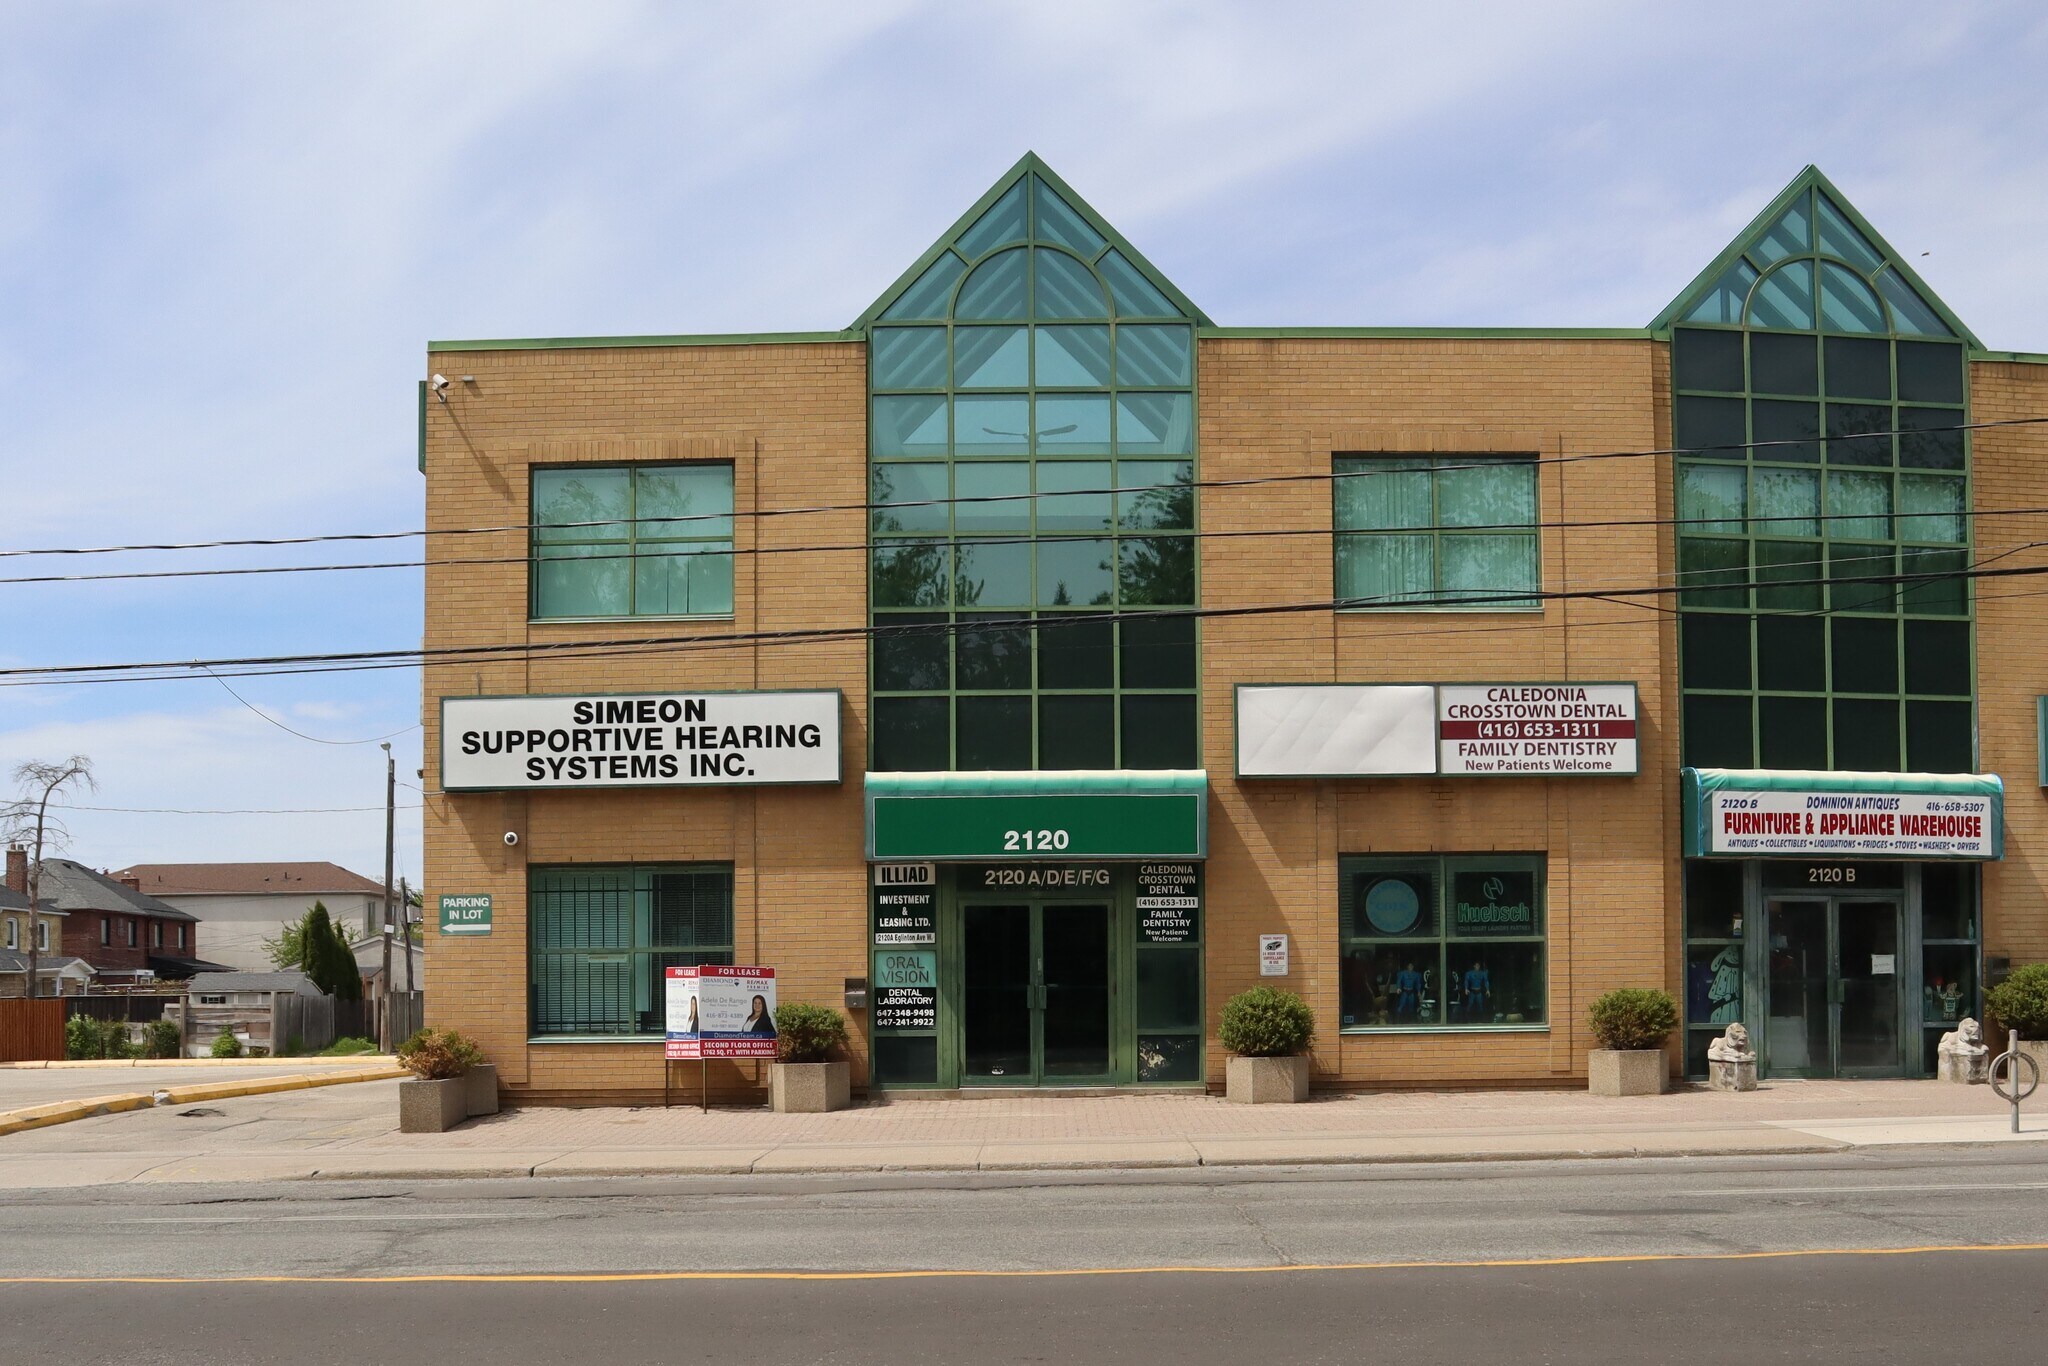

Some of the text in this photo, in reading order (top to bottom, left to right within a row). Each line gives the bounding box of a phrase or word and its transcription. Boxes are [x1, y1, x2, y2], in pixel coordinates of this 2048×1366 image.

[1487, 688, 1587, 702] CALEDONIA
[573, 700, 706, 724] SIMEON
[1448, 703, 1627, 719] CROSSTOWN DENTAL
[1478, 721, 1600, 739] (416) 653-1311
[462, 724, 821, 754] SUPPORTIVE HEARING
[1458, 742, 1618, 757] FAMILY DENTISTRY
[526, 753, 755, 780] SYSTEMS INC.
[1465, 759, 1612, 771] New Patients Welcome
[1720, 799, 1758, 809] 2120 B
[1806, 796, 1900, 810] DOMINION ANTIQUES
[1926, 802, 1985, 812] 416-658-5307
[1724, 812, 1981, 838] FURNITURE & APPLIANCE WAREHOUSE
[1004, 829, 1069, 850] 2120
[1728, 839, 1758, 848] ANTIQUES
[1765, 839, 1807, 848] COLLECTIBLES
[1814, 840, 1856, 848] LIQUIDATIONS
[1862, 840, 1888, 849] FRIDGES
[1895, 841, 1917, 849] STOVES
[1923, 841, 1950, 850] WASHERS
[881, 866, 929, 883] ILLIAD
[1140, 865, 1193, 874] CALEDONIA
[1809, 868, 1856, 882] 2120 B
[985, 869, 1110, 887] 2120 A/D/E/F/G
[1138, 875, 1196, 884] CROSSTOWN
[1149, 885, 1185, 894] DENTAL
[443, 897, 489, 908] PARKING
[879, 895, 930, 905] INVESTMENT
[1138, 898, 1195, 906] (416) 653-1311
[449, 909, 483, 920] IN LOT
[902, 907, 908, 915] &
[1151, 910, 1183, 918] FAMILY
[1457, 902, 1530, 922] Huebsch
[879, 917, 931, 927] LEASING LTD.
[1142, 919, 1191, 927] DENTISTRY
[886, 956, 925, 969] ORAL
[737, 968, 761, 976] LEASE
[882, 970, 929, 983] VISION
[878, 997, 933, 1005] LABORATORY
